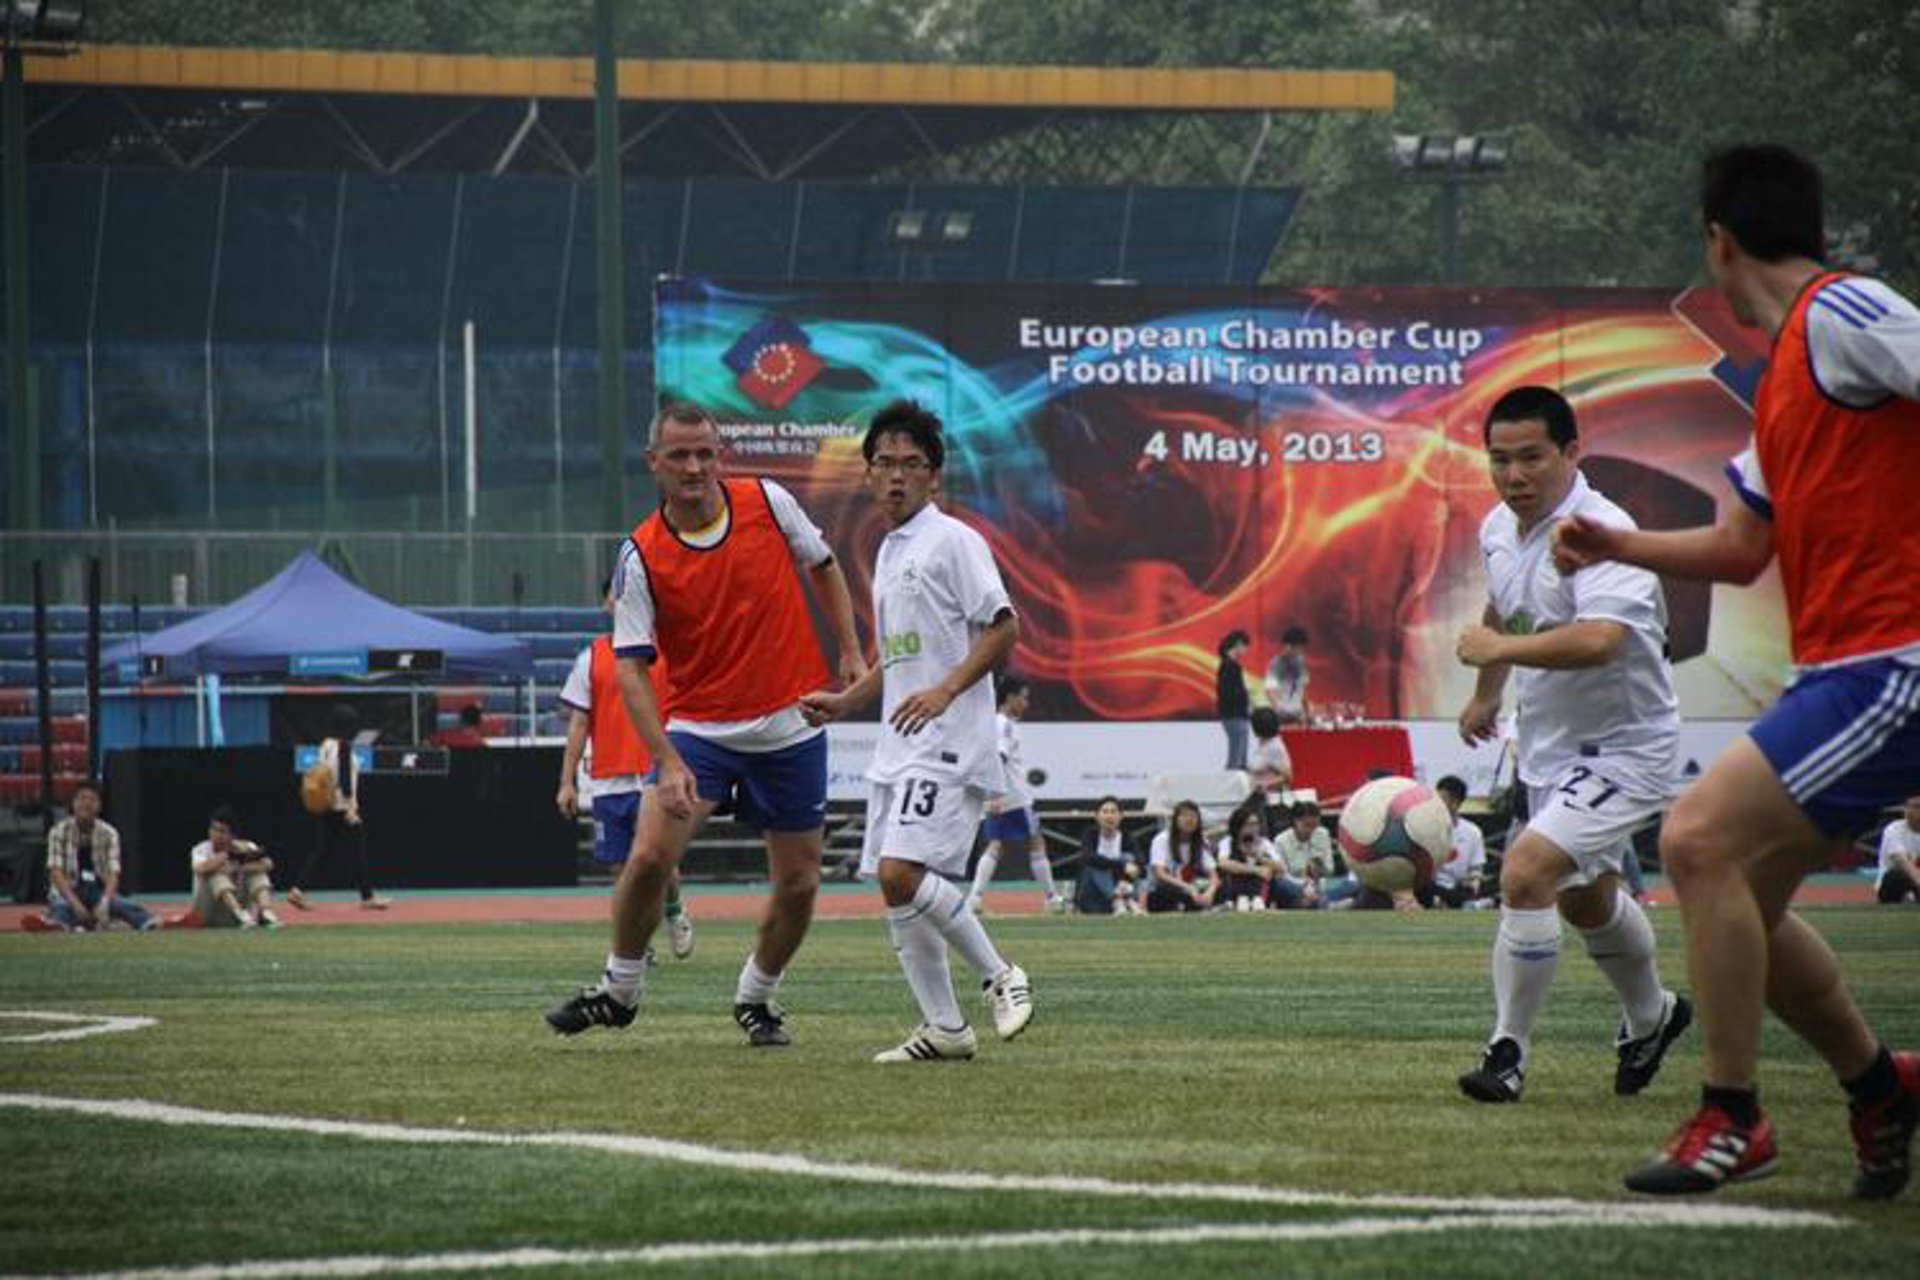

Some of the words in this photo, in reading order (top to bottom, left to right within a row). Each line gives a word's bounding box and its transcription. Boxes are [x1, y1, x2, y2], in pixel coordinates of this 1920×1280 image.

[1019, 318, 1207, 354] European
[1220, 319, 1395, 350] Chamber
[1406, 321, 1483, 357] Cup
[1049, 354, 1212, 385] Football
[1224, 356, 1464, 386] Tournament
[779, 421, 858, 436] Chamber
[1143, 430, 1169, 461] 4
[1181, 431, 1270, 467] May,
[1282, 431, 1383, 462] 2013
[900, 778, 939, 818] 13
[1558, 765, 1620, 809] 27
